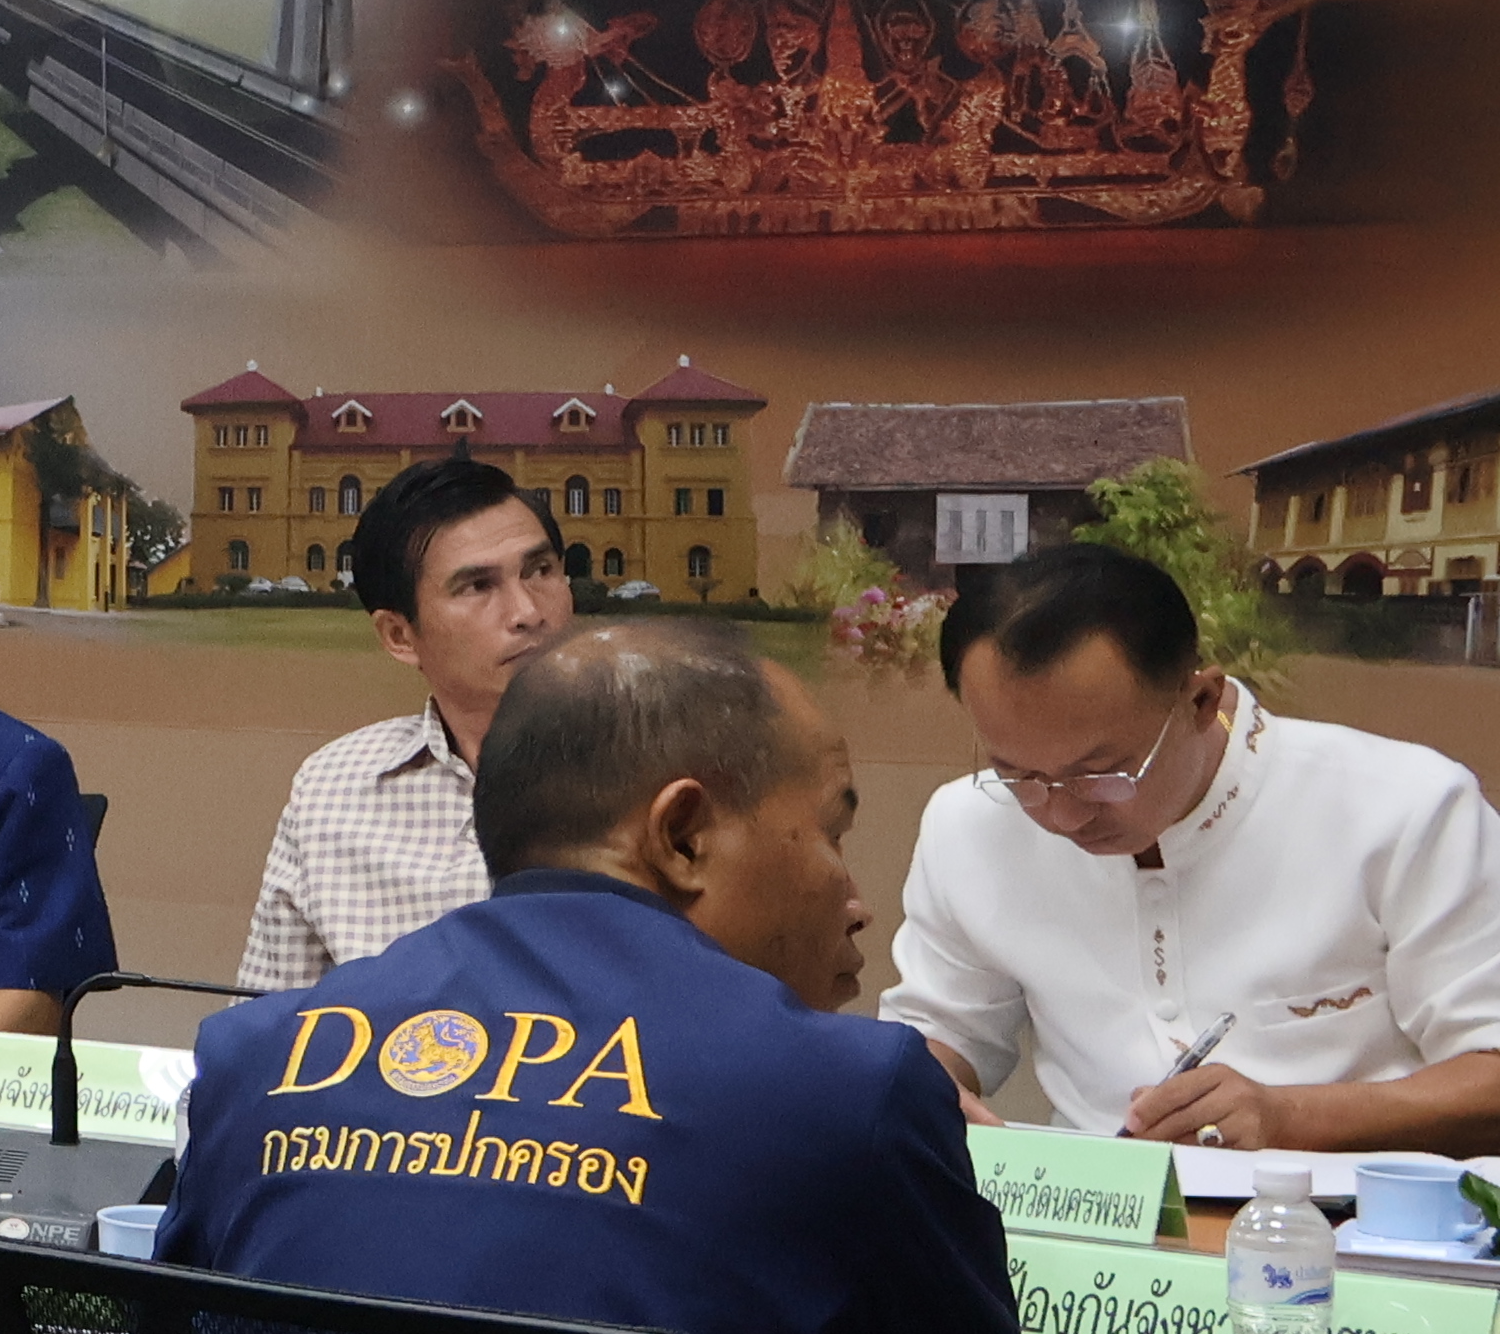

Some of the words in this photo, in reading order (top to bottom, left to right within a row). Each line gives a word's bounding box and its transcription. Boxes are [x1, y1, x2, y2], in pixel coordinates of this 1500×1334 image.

[262, 1109, 649, 1206] กรมการปกครอง
[979, 1161, 1145, 1230] จังหวัดนครพนม
[29, 1221, 82, 1241] NPE
